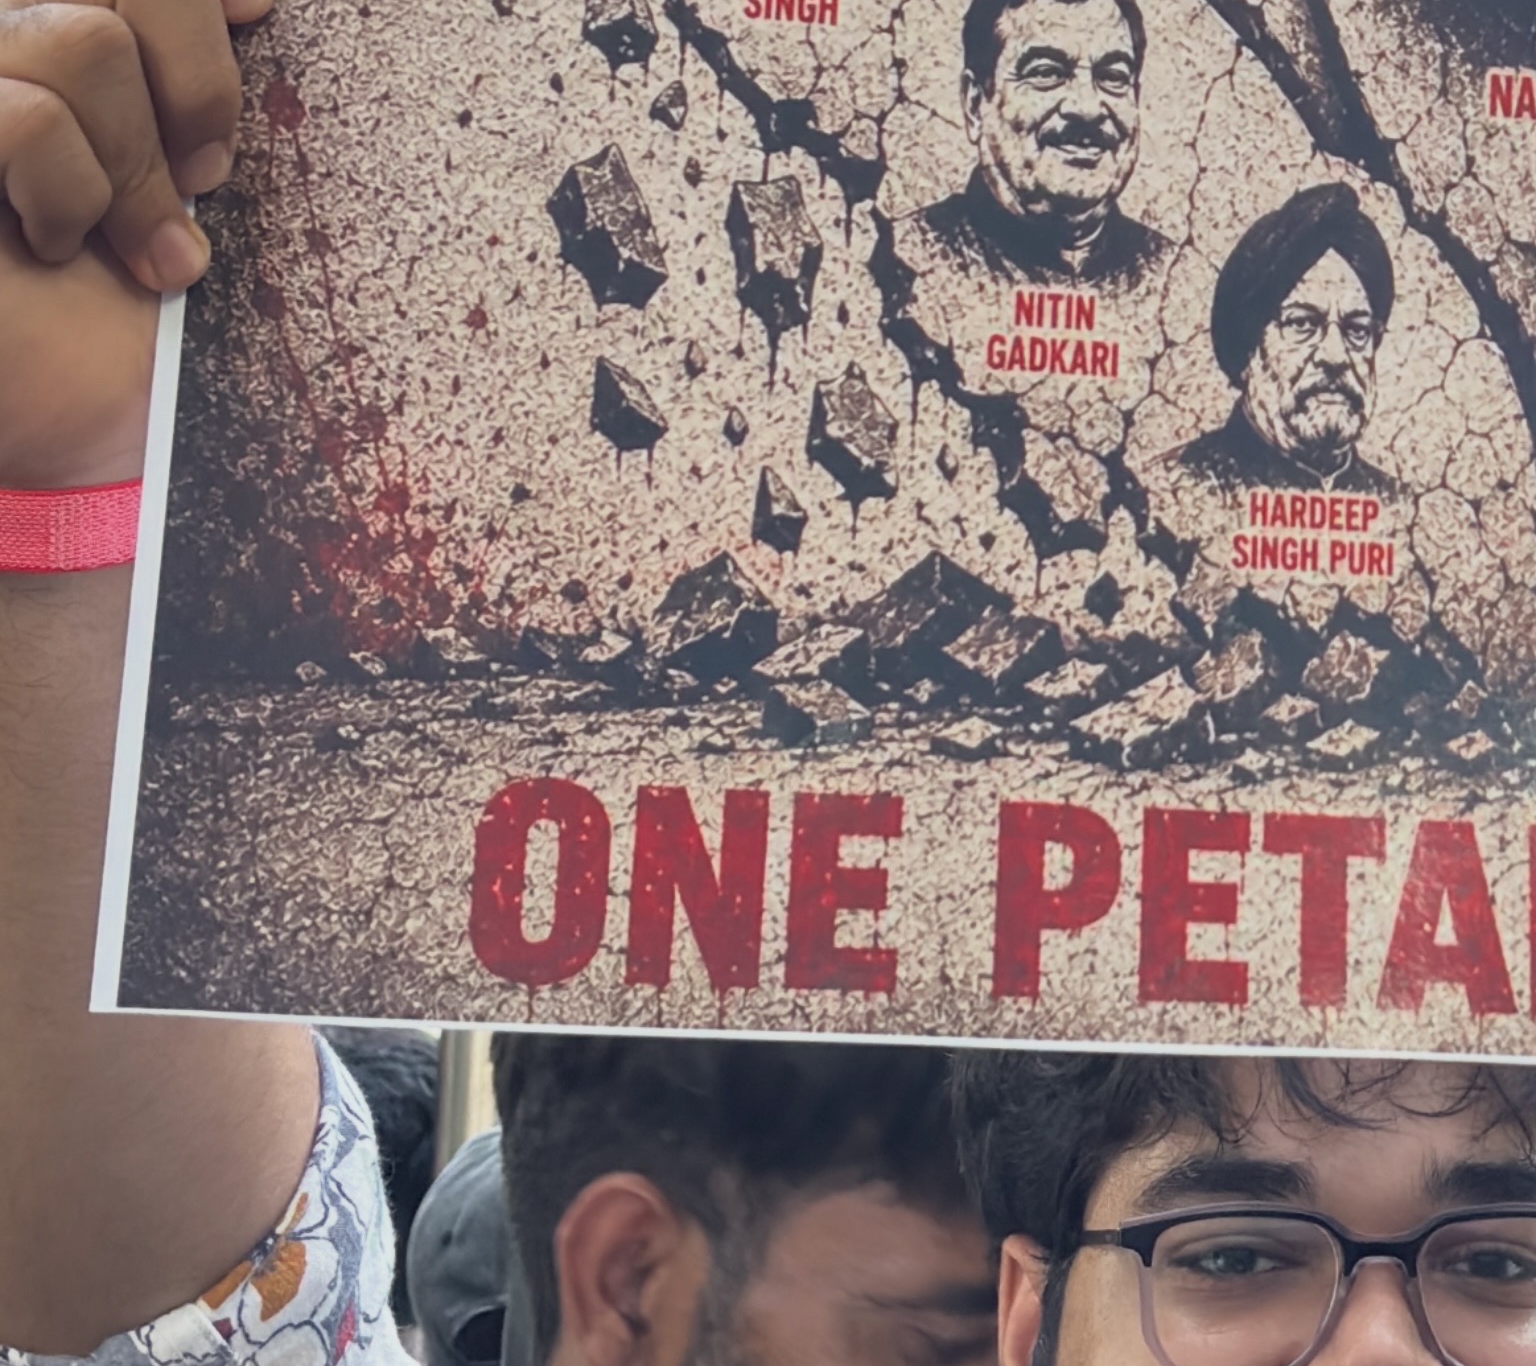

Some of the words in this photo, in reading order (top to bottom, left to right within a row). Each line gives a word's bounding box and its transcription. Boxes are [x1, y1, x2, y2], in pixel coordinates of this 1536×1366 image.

[1014, 290, 1096, 331] NITIN
[986, 333, 1120, 378] GADKARI
[1250, 491, 1380, 532] HARDEEP
[1231, 534, 1319, 572] SINGH
[1330, 539, 1394, 577] PURI
[467, 775, 904, 993] ONE
